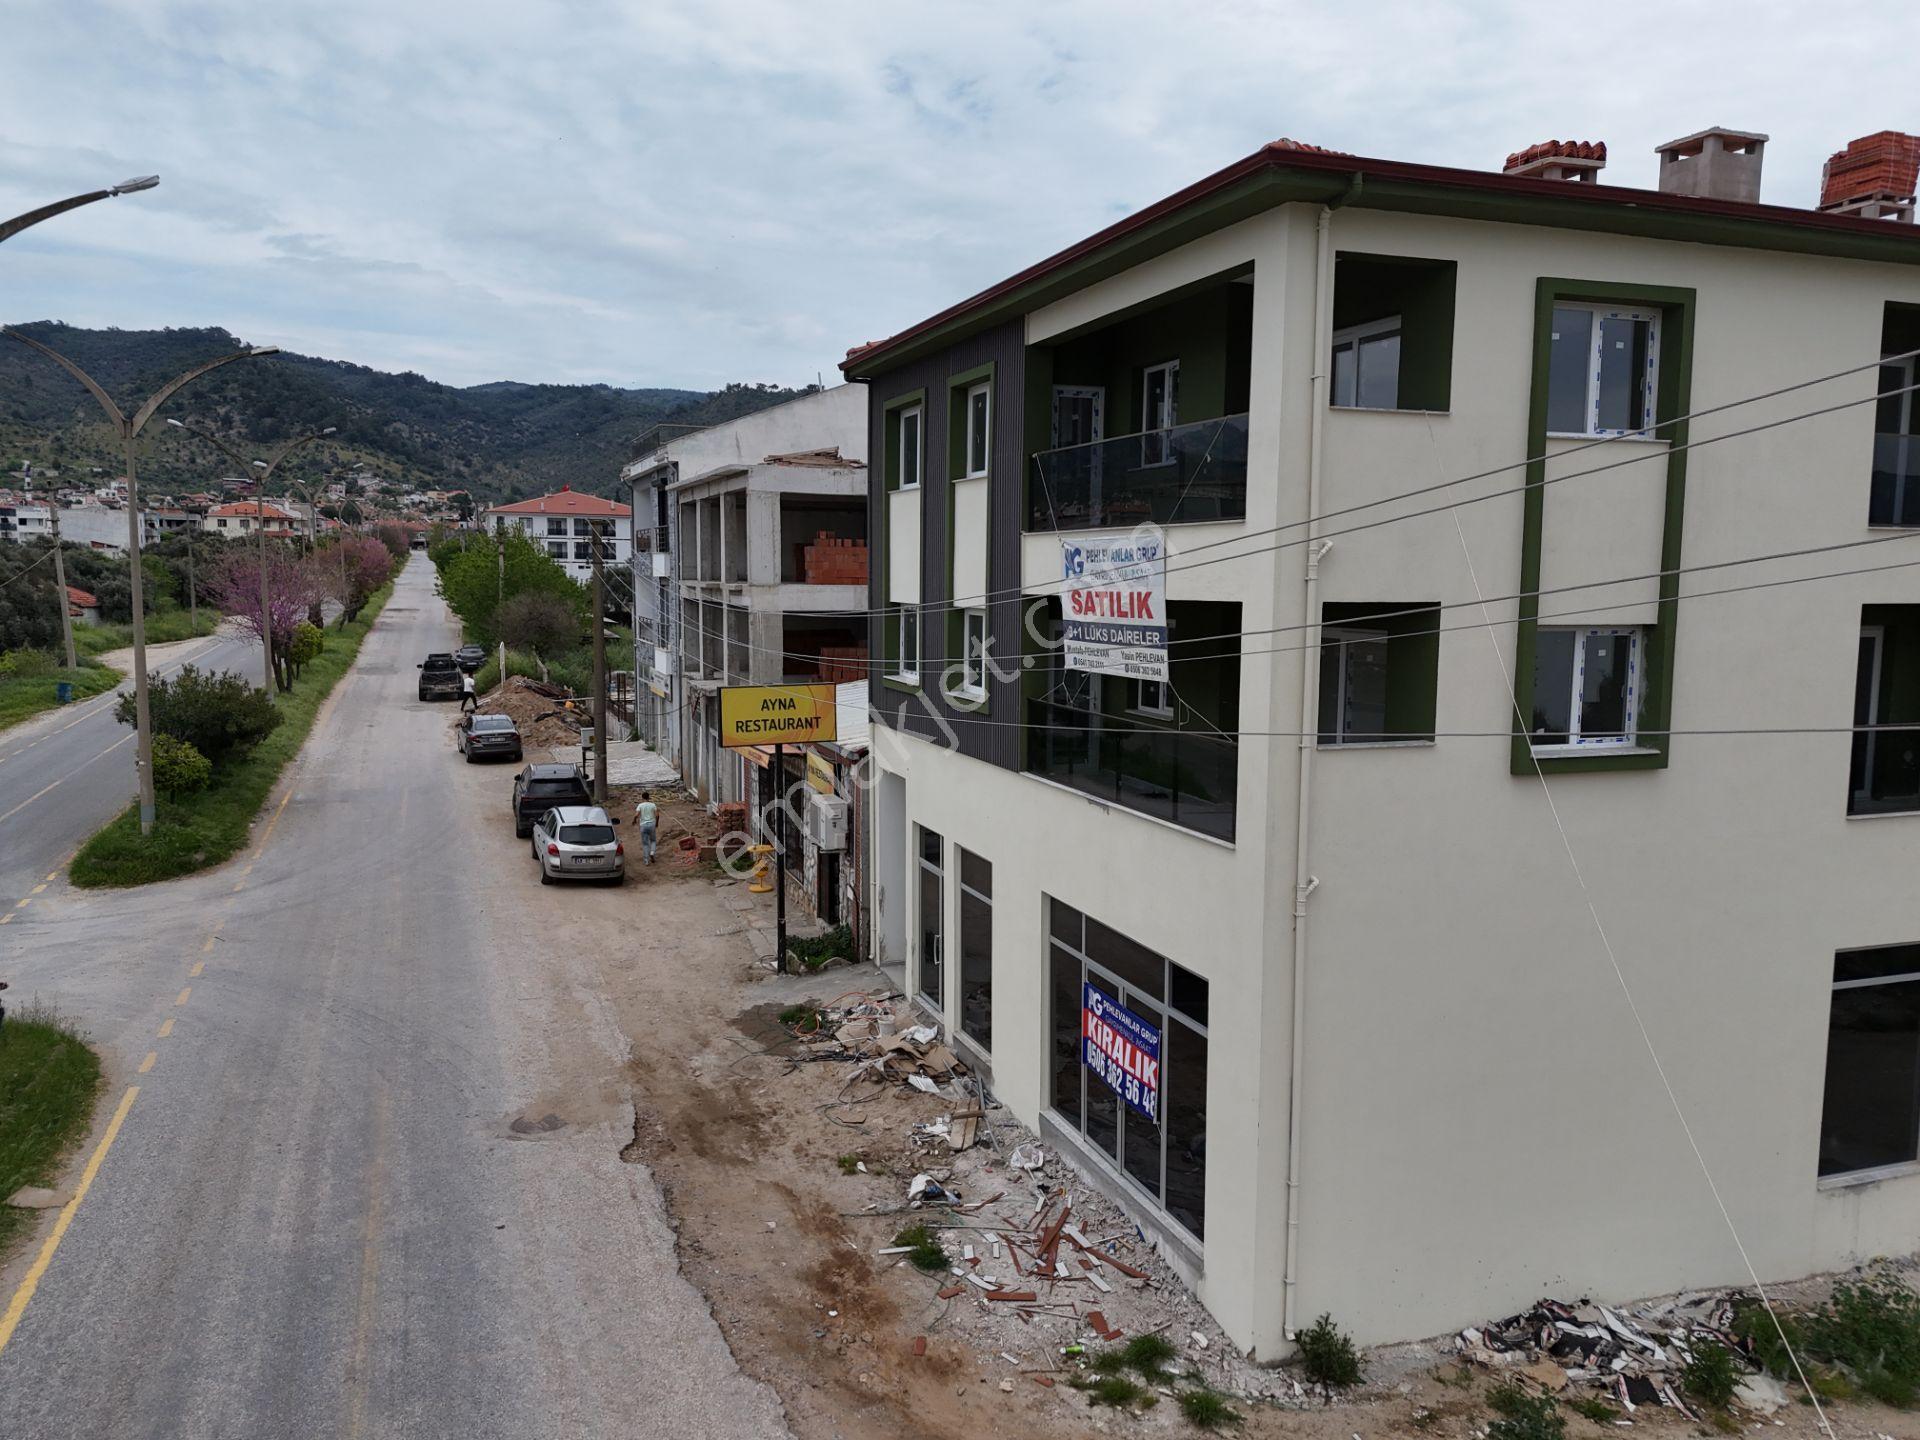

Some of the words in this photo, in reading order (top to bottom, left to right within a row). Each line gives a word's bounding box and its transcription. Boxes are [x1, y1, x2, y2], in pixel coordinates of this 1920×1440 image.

[1136, 546, 1158, 560] GRUP
[1071, 589, 1153, 619] SATILIK
[1068, 625, 1082, 639] 3+1
[1085, 625, 1109, 642] LÜKS
[1110, 627, 1160, 645] DAİRELER
[1136, 652, 1165, 664] PEHLEVAN
[761, 697, 796, 712] AYNA
[736, 716, 821, 733] RESTAURANT
[1103, 1000, 1140, 1034] PEHLEVANLAR
[1141, 1028, 1158, 1045] GRUP
[1087, 1040, 1105, 1077] 0506
[1107, 1058, 1122, 1094] 362
[1125, 1073, 1139, 1105] 56
